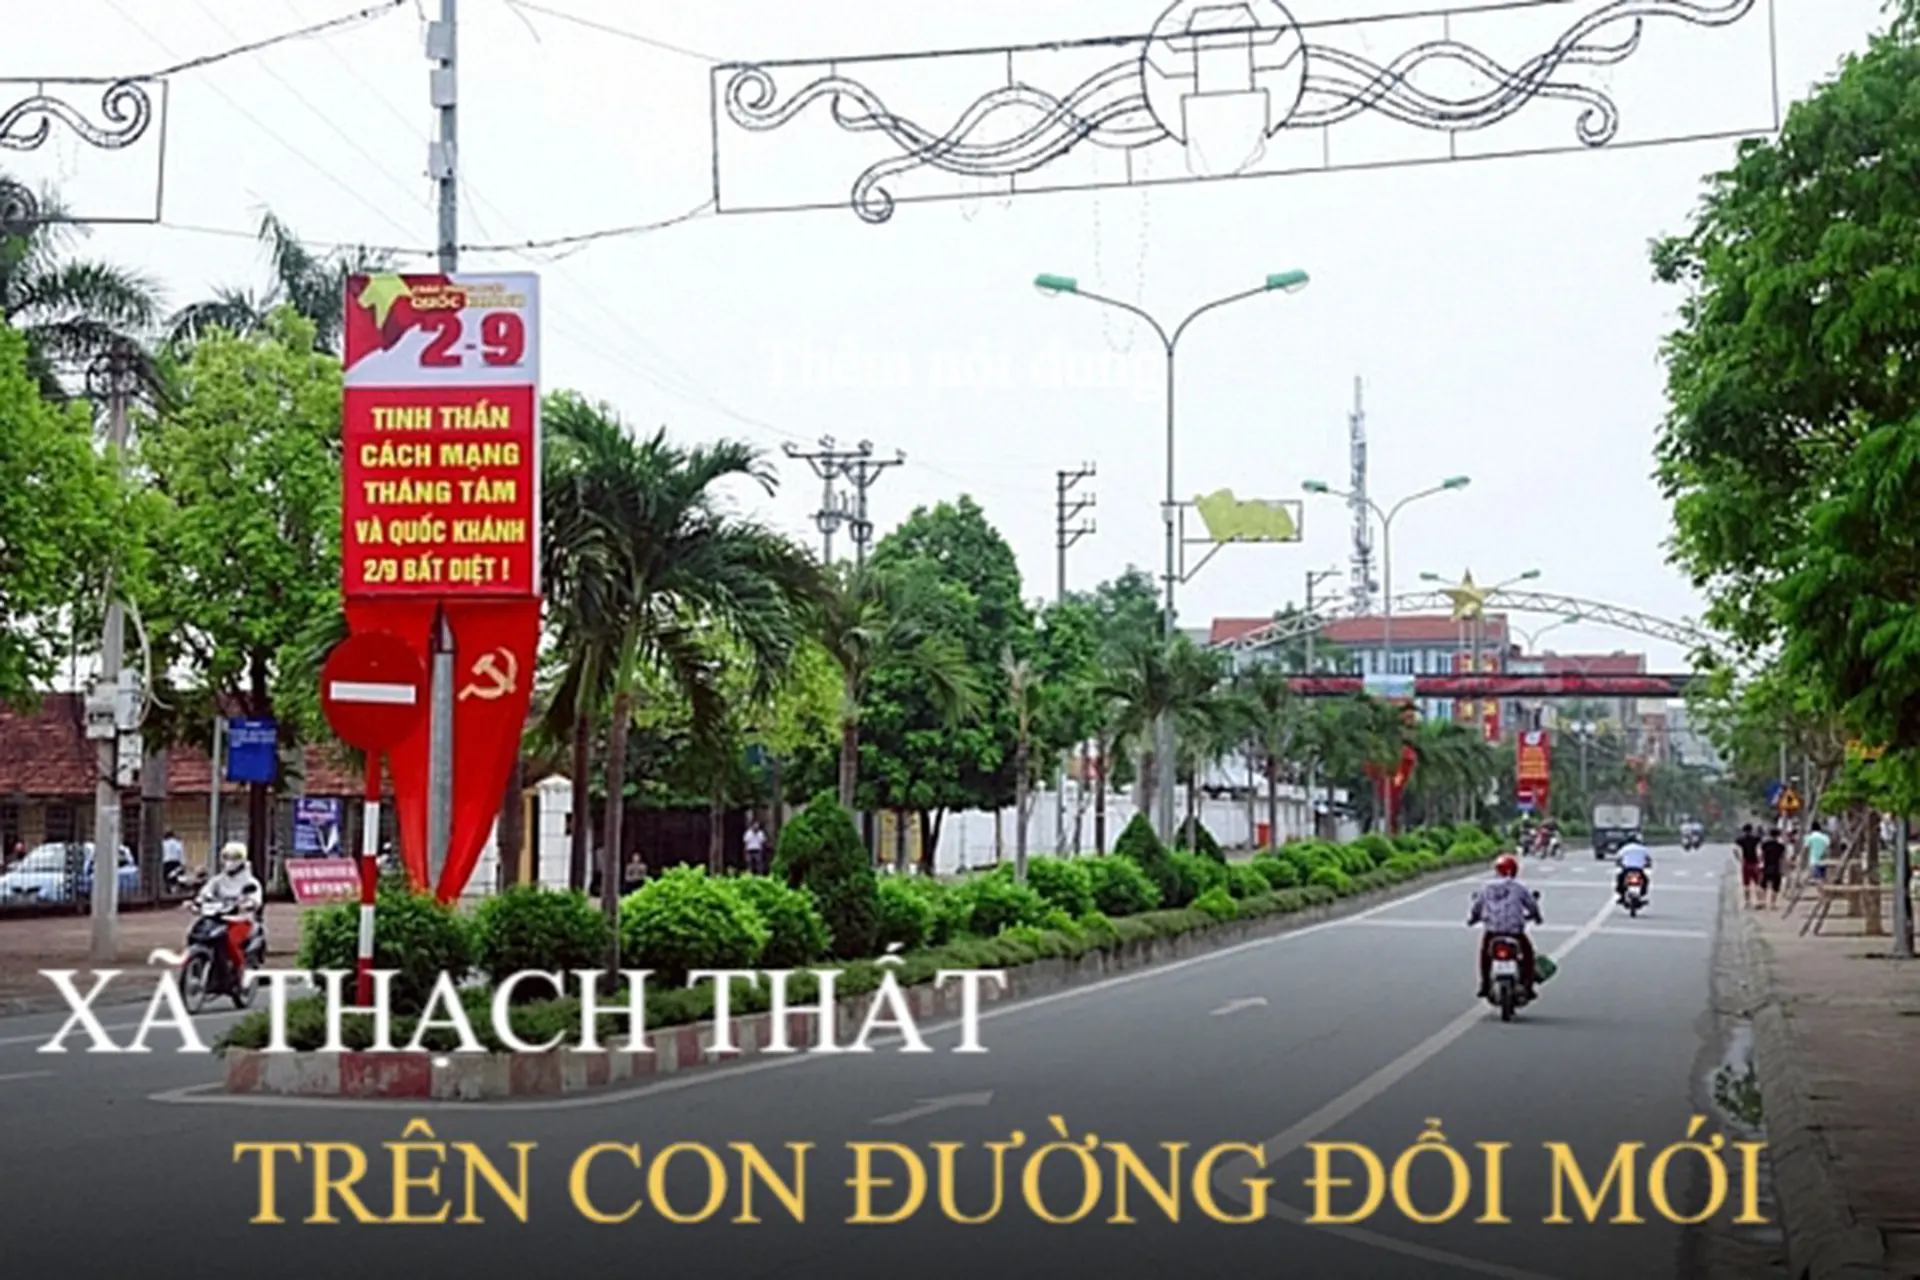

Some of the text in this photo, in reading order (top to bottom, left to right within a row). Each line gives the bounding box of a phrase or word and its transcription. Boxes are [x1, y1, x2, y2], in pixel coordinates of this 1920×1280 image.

[418, 311, 525, 368] 2-9
[371, 406, 432, 430] TINH
[360, 438, 520, 471] CÁCH MẠNG
[363, 475, 516, 504] THÁNG TÁM
[355, 512, 525, 546] VÀ QUỐC KHÁNH
[363, 550, 510, 586] 2/9 BẤT DIỆT !
